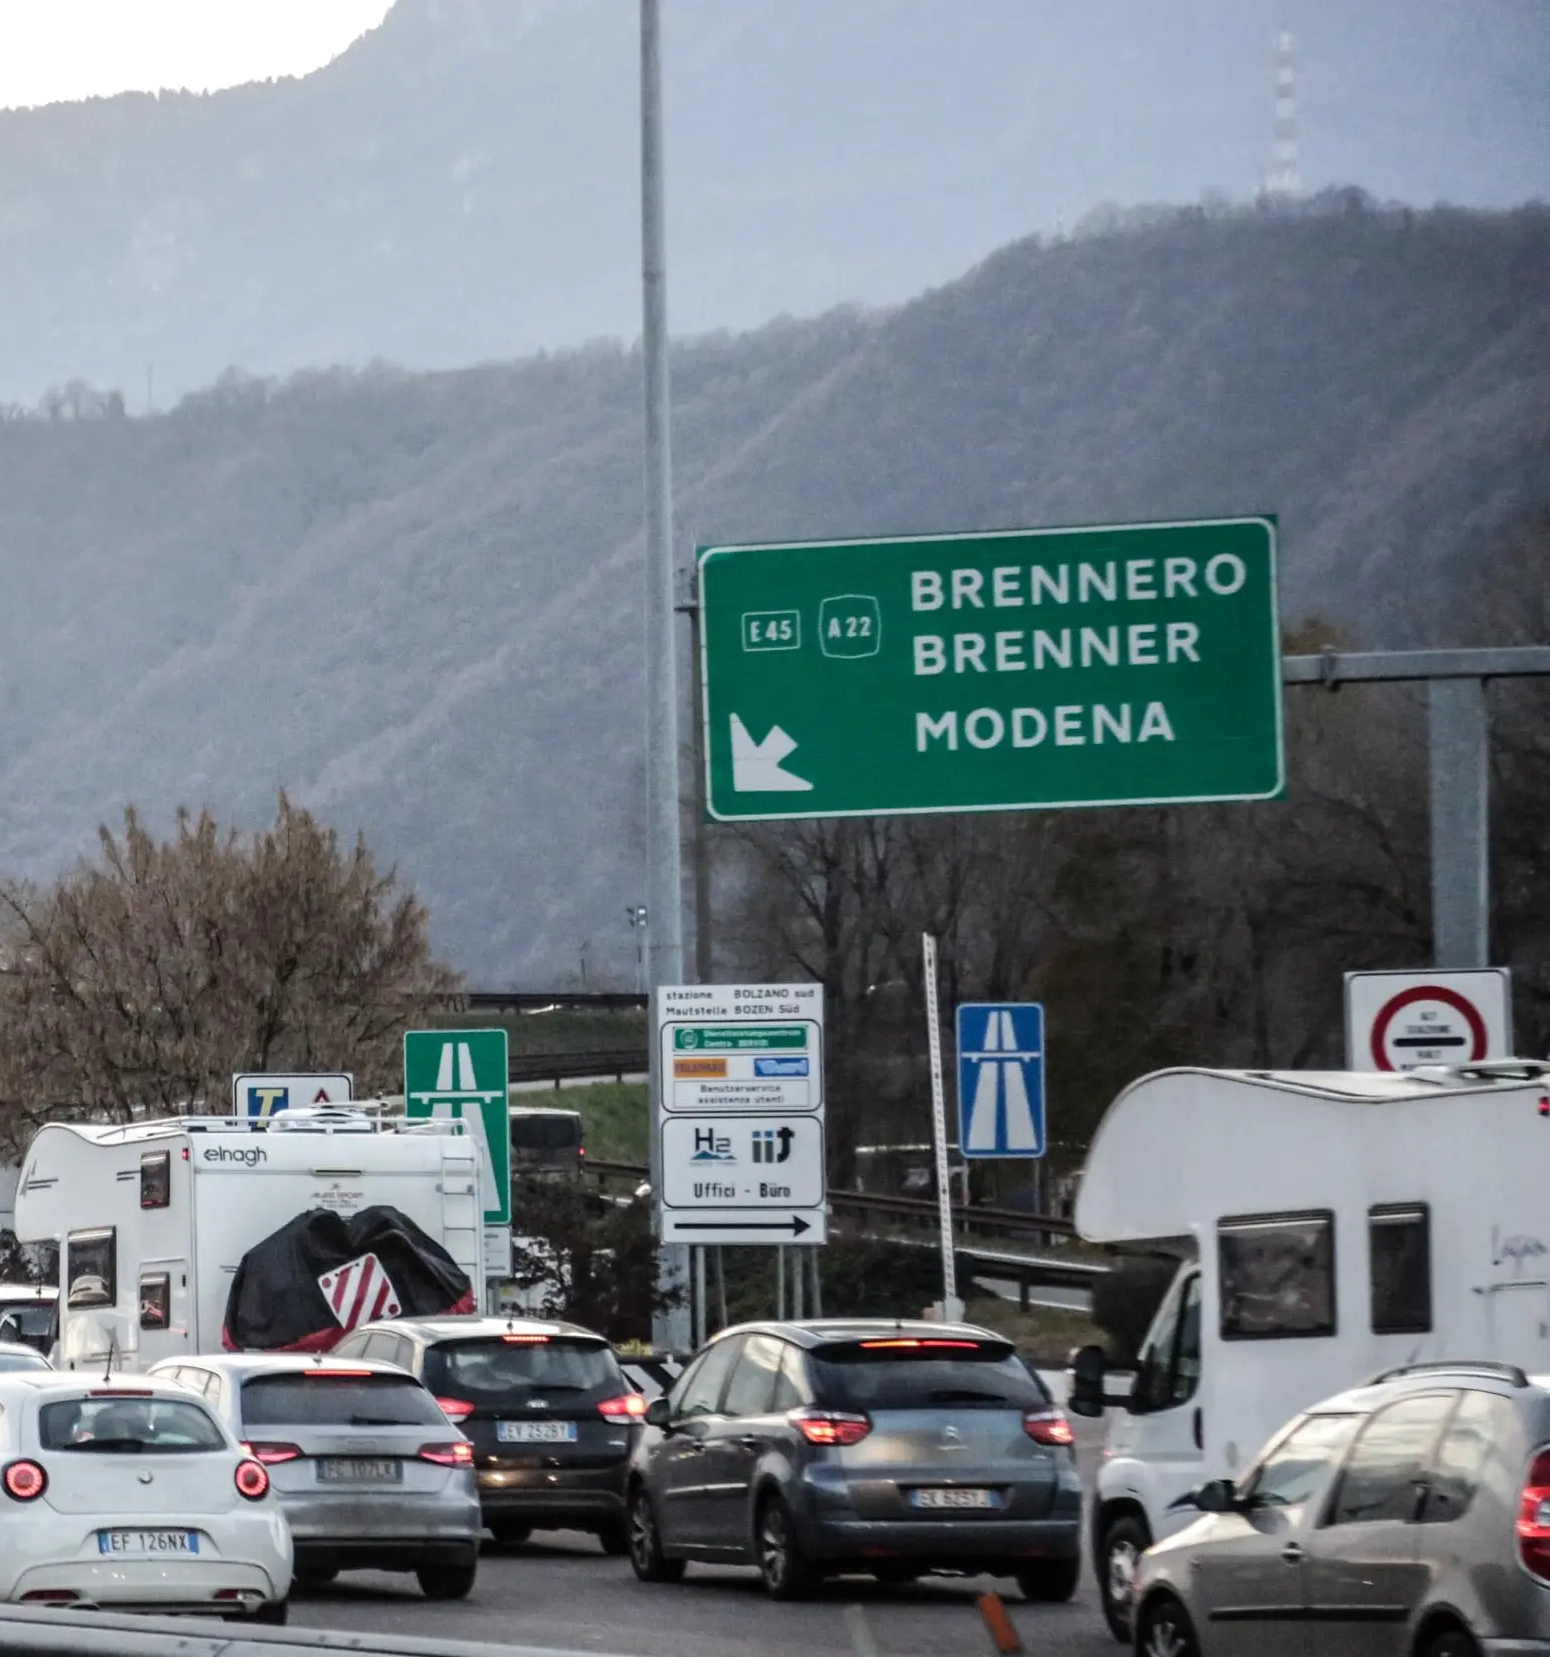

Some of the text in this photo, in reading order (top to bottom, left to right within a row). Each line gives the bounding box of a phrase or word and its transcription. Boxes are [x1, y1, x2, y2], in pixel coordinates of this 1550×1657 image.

[911, 553, 1246, 612] BRENNERO
[750, 620, 792, 642] E 45
[828, 616, 871, 638] A 22
[913, 622, 1201, 675] BRENNER
[915, 701, 1176, 752] MODENA
[666, 991, 713, 1000] stazione
[734, 989, 789, 999] BOLZANO
[666, 1004, 800, 1016] Mautstelle BOZEN Süd
[256, 1089, 284, 1128] T
[203, 1146, 267, 1167] elnagh
[694, 1182, 735, 1198] Uffici
[759, 1182, 791, 1198] Büro
[110, 1533, 187, 1551] EF 126NX
